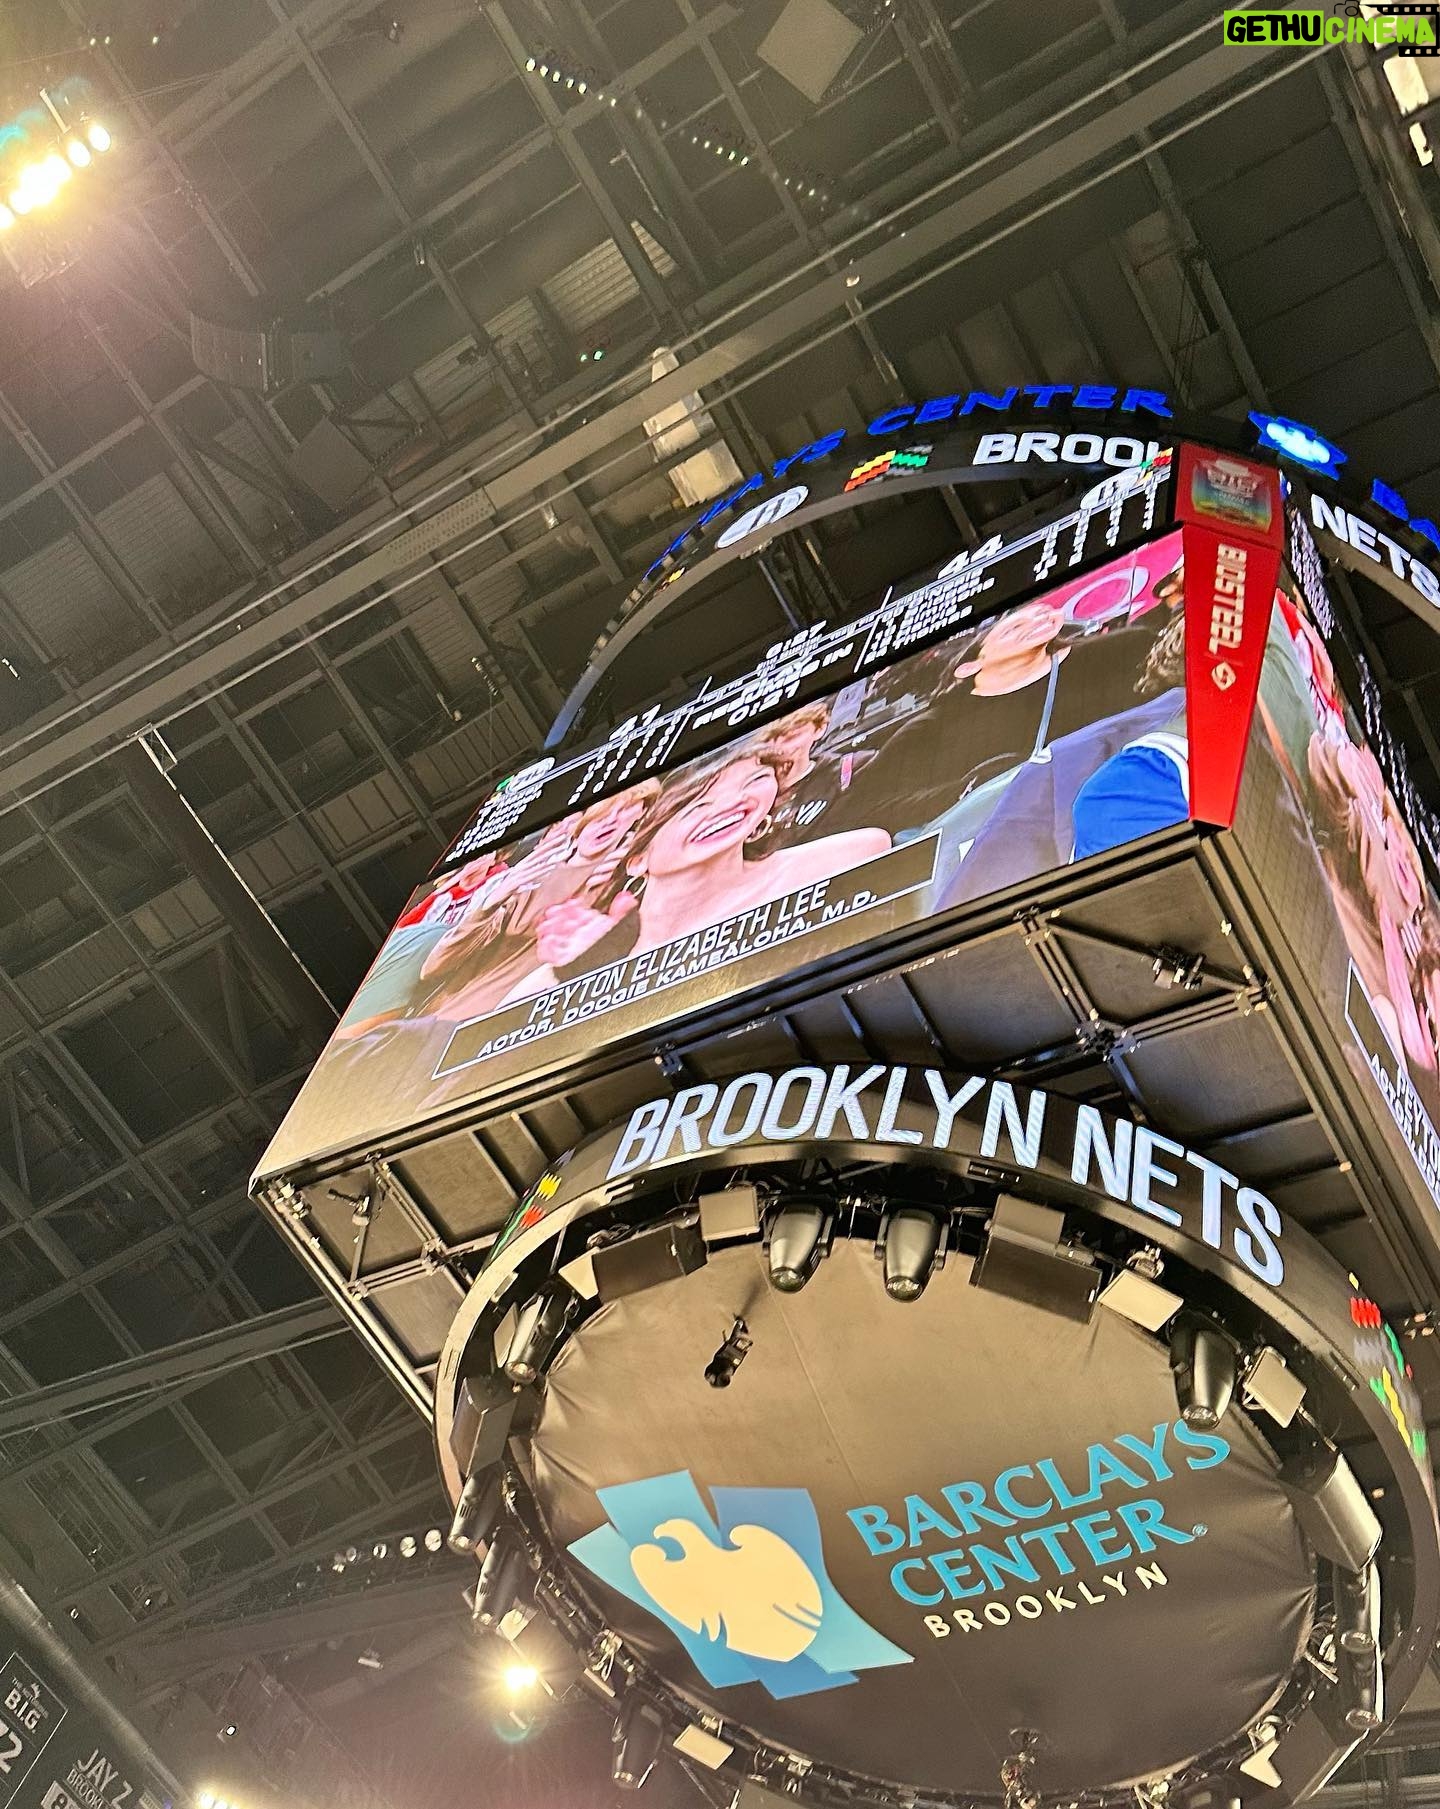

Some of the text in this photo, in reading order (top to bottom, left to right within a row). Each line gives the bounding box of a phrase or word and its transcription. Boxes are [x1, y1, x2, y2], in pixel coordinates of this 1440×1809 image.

[866, 384, 1174, 436] CENTER
[1310, 493, 1440, 609] NETS
[1208, 543, 1247, 655] BIOSTEEL
[528, 879, 831, 1024] PEYTON ELIZABETH LEE
[821, 889, 878, 922] M.D.
[606, 1064, 1285, 1287] BROOKLYN NETS
[846, 1418, 1231, 1556] BARCLAYS
[923, 1561, 1169, 1639] BROOKLYN
[4, 1687, 41, 1735] B.I.G.
[77, 1748, 119, 1793] JAY
